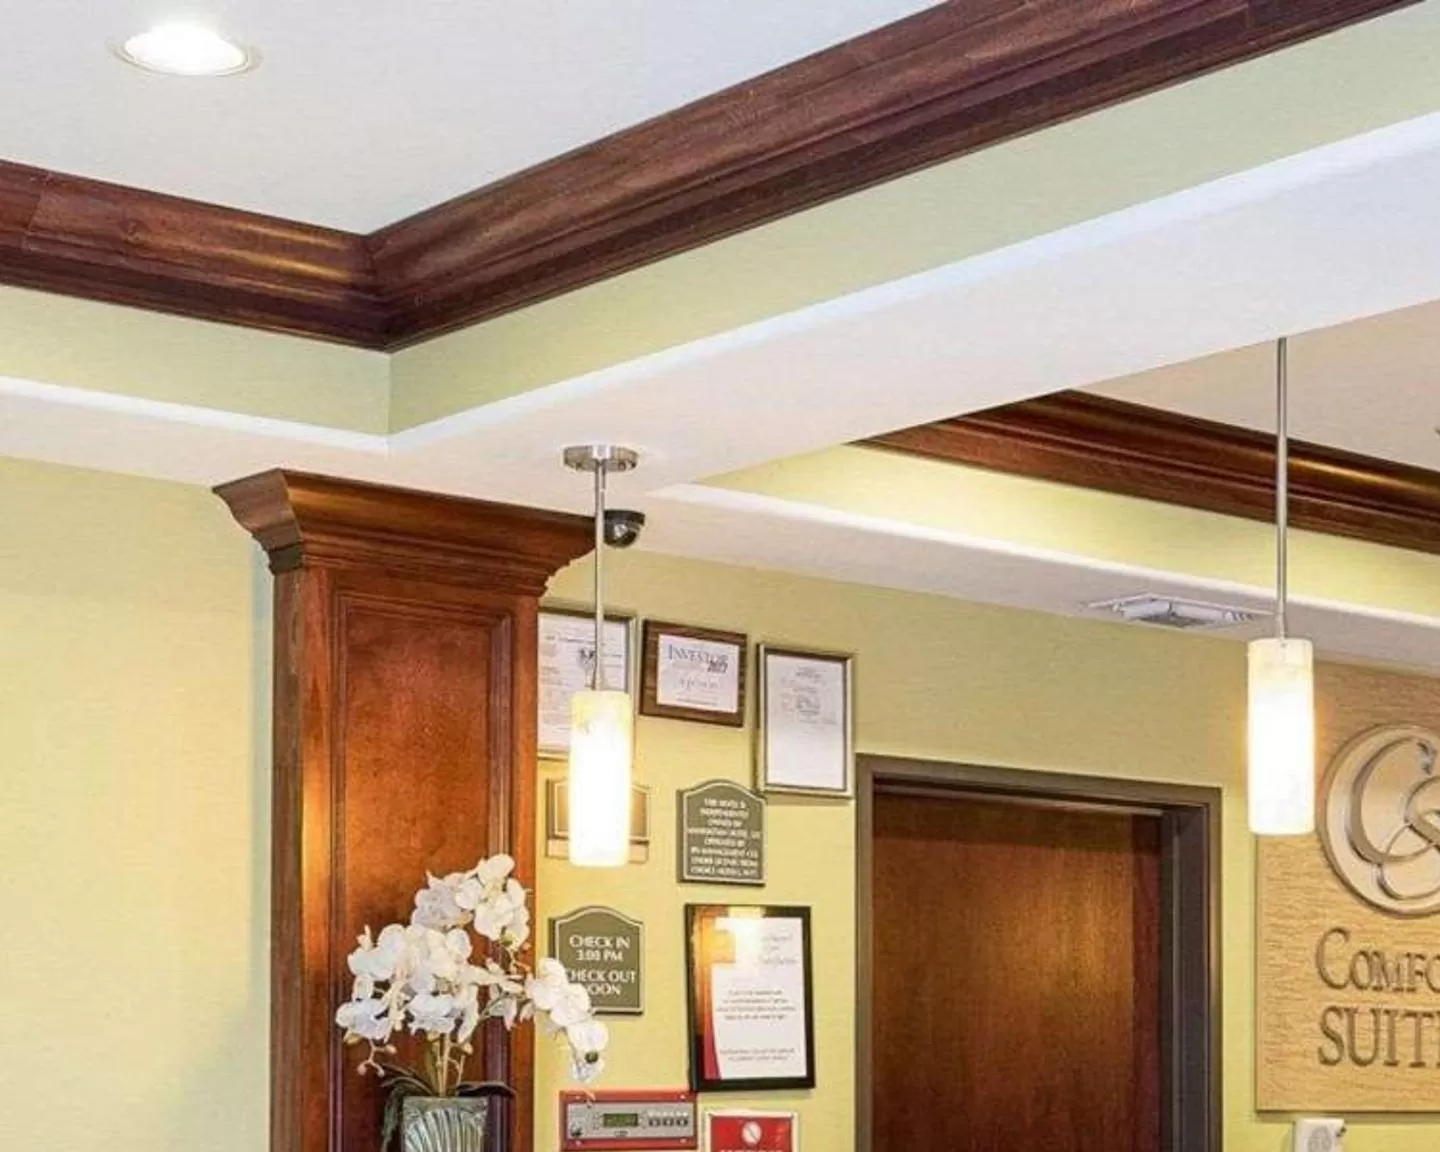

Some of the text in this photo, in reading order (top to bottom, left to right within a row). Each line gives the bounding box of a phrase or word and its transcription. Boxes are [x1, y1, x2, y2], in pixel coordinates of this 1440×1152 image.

[569, 934, 631, 949] CHECK IN
[603, 949, 624, 962] PM
[608, 969, 637, 984] OUT
[585, 982, 622, 996] OON
